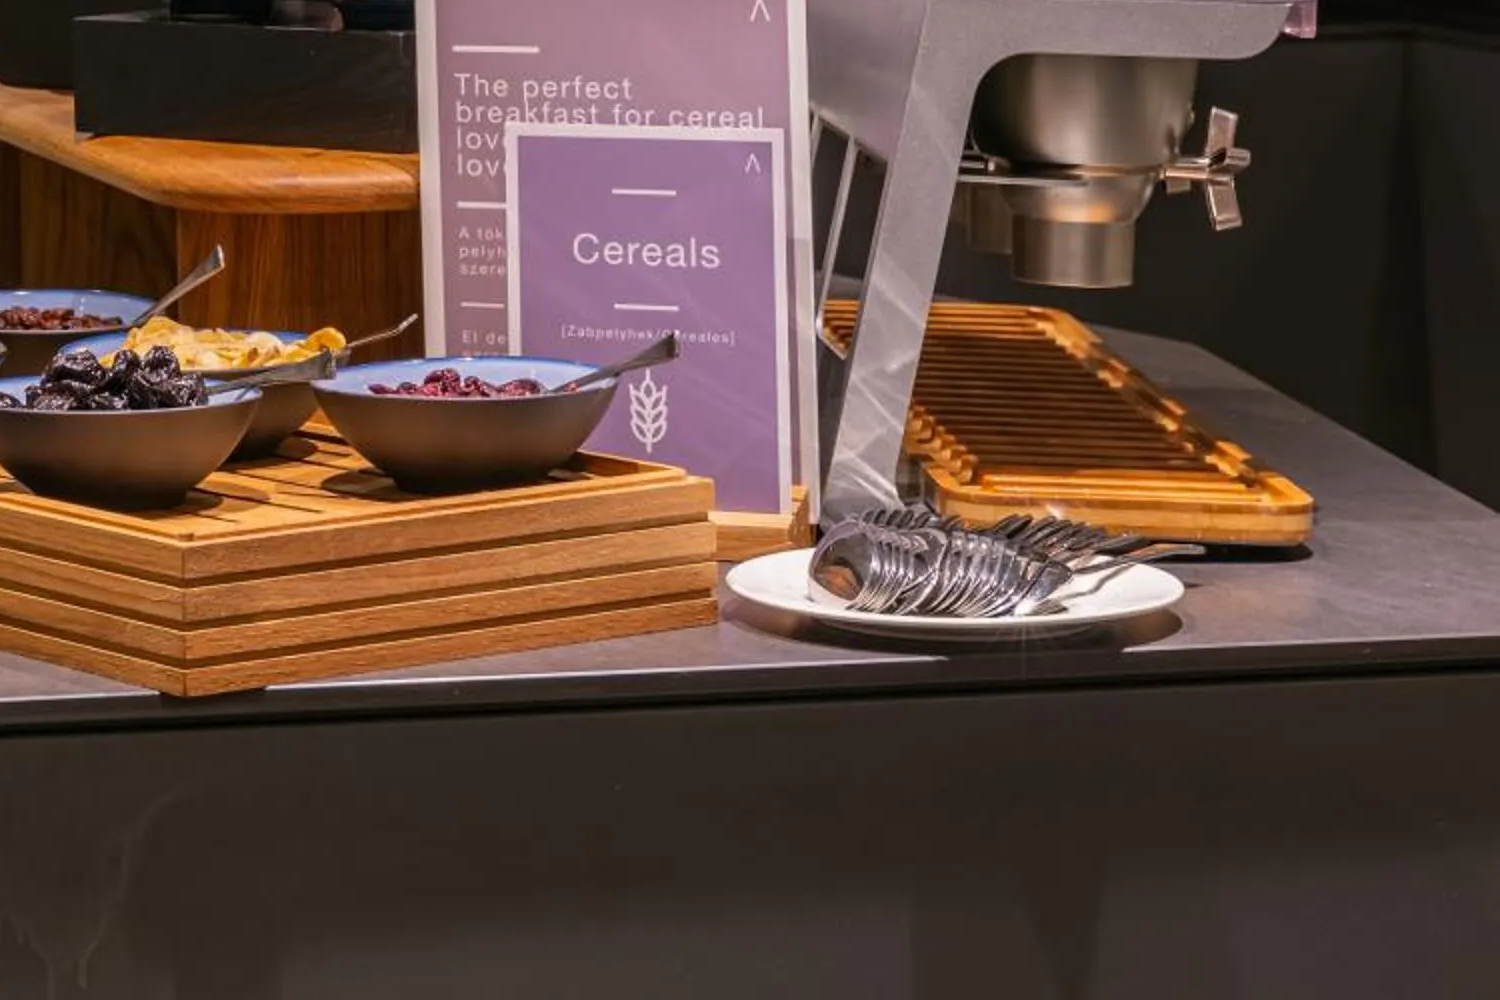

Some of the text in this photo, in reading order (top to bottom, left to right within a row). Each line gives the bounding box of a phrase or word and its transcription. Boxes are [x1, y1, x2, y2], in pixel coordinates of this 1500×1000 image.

[453, 73, 632, 104] The perfect
[456, 101, 764, 128] breakfast for cereal
[456, 127, 506, 150] lov
[456, 153, 506, 177] lov
[573, 232, 721, 269] Cereals
